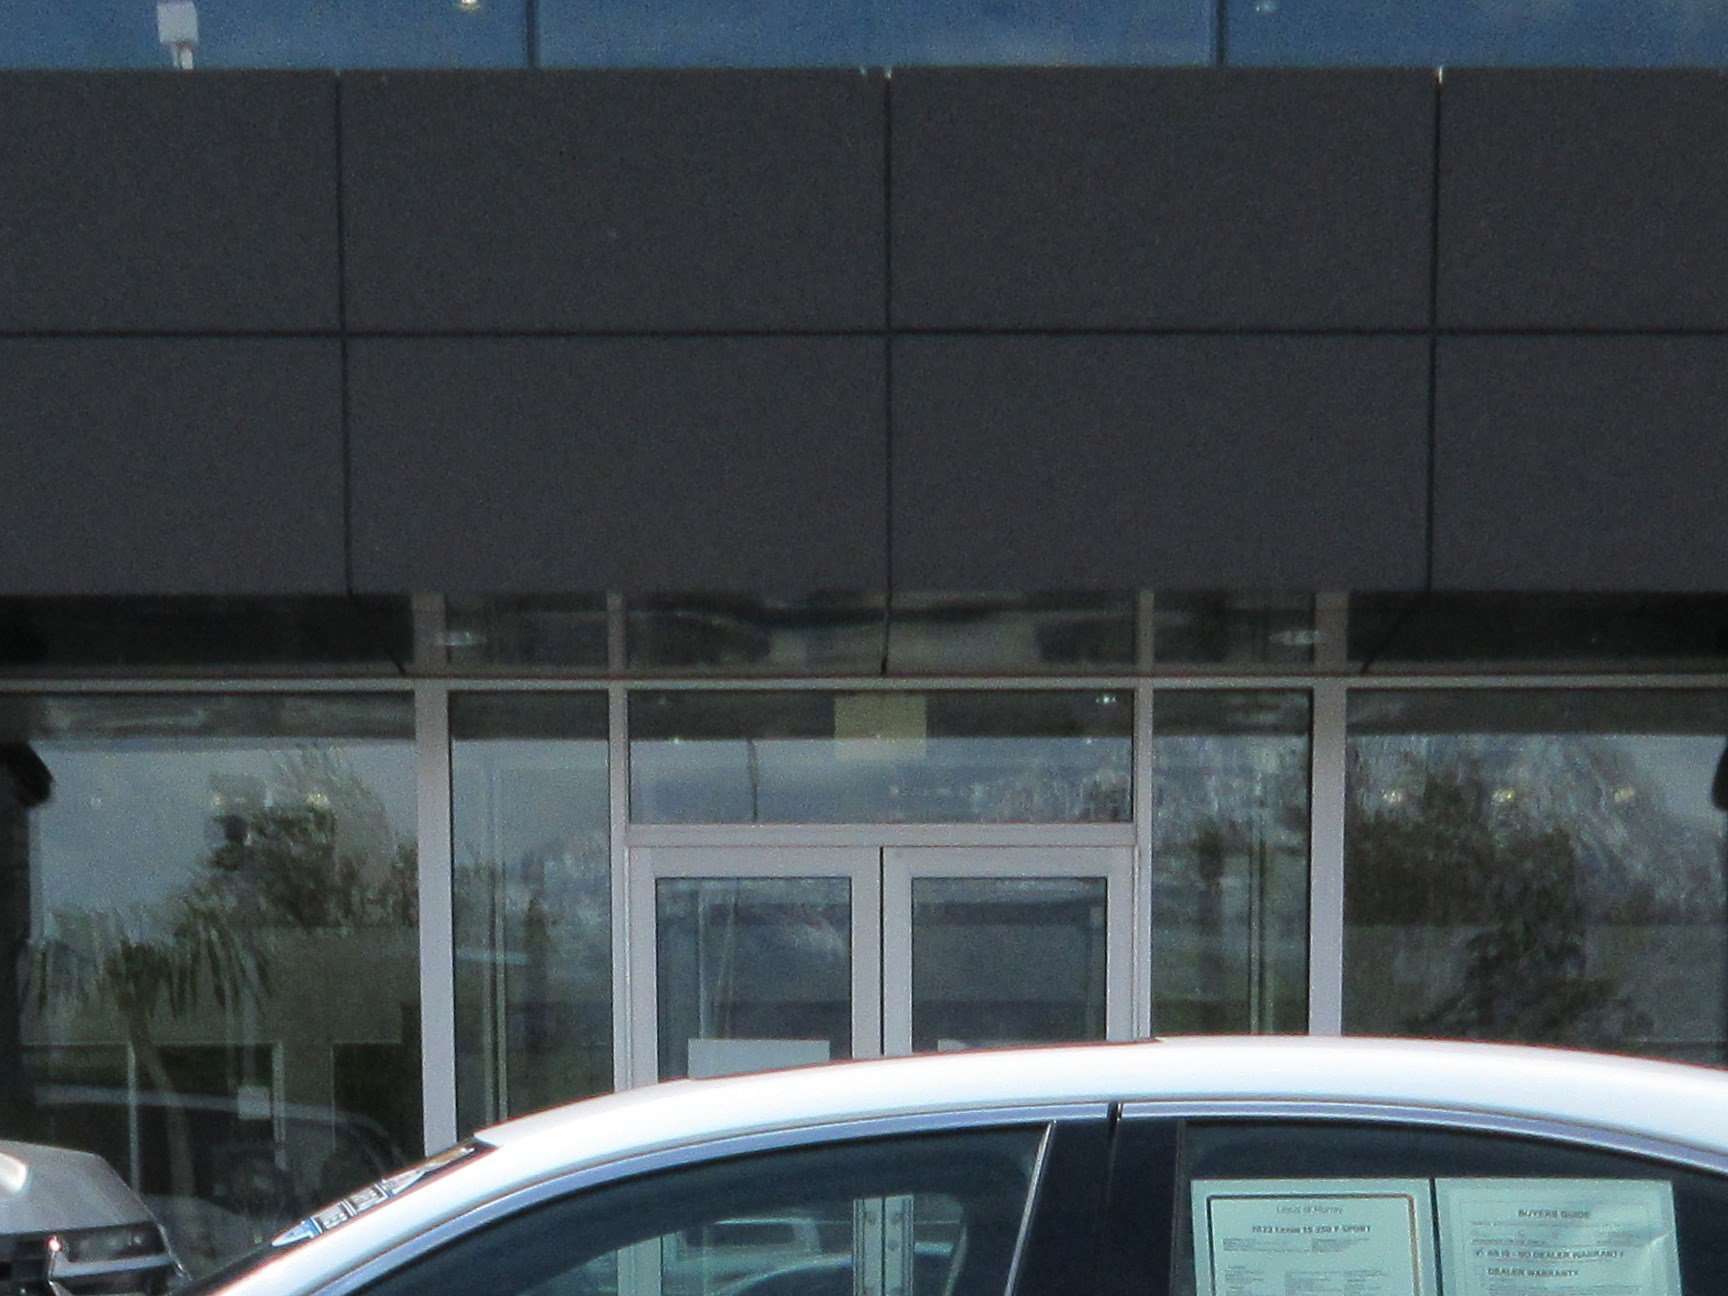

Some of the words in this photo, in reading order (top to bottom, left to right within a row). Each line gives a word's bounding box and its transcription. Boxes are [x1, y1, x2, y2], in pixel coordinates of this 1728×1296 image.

[1518, 1209, 1558, 1218] BUYERS
[1560, 1210, 1590, 1219] GUIDE
[1488, 1267, 1526, 1276] DEALER
